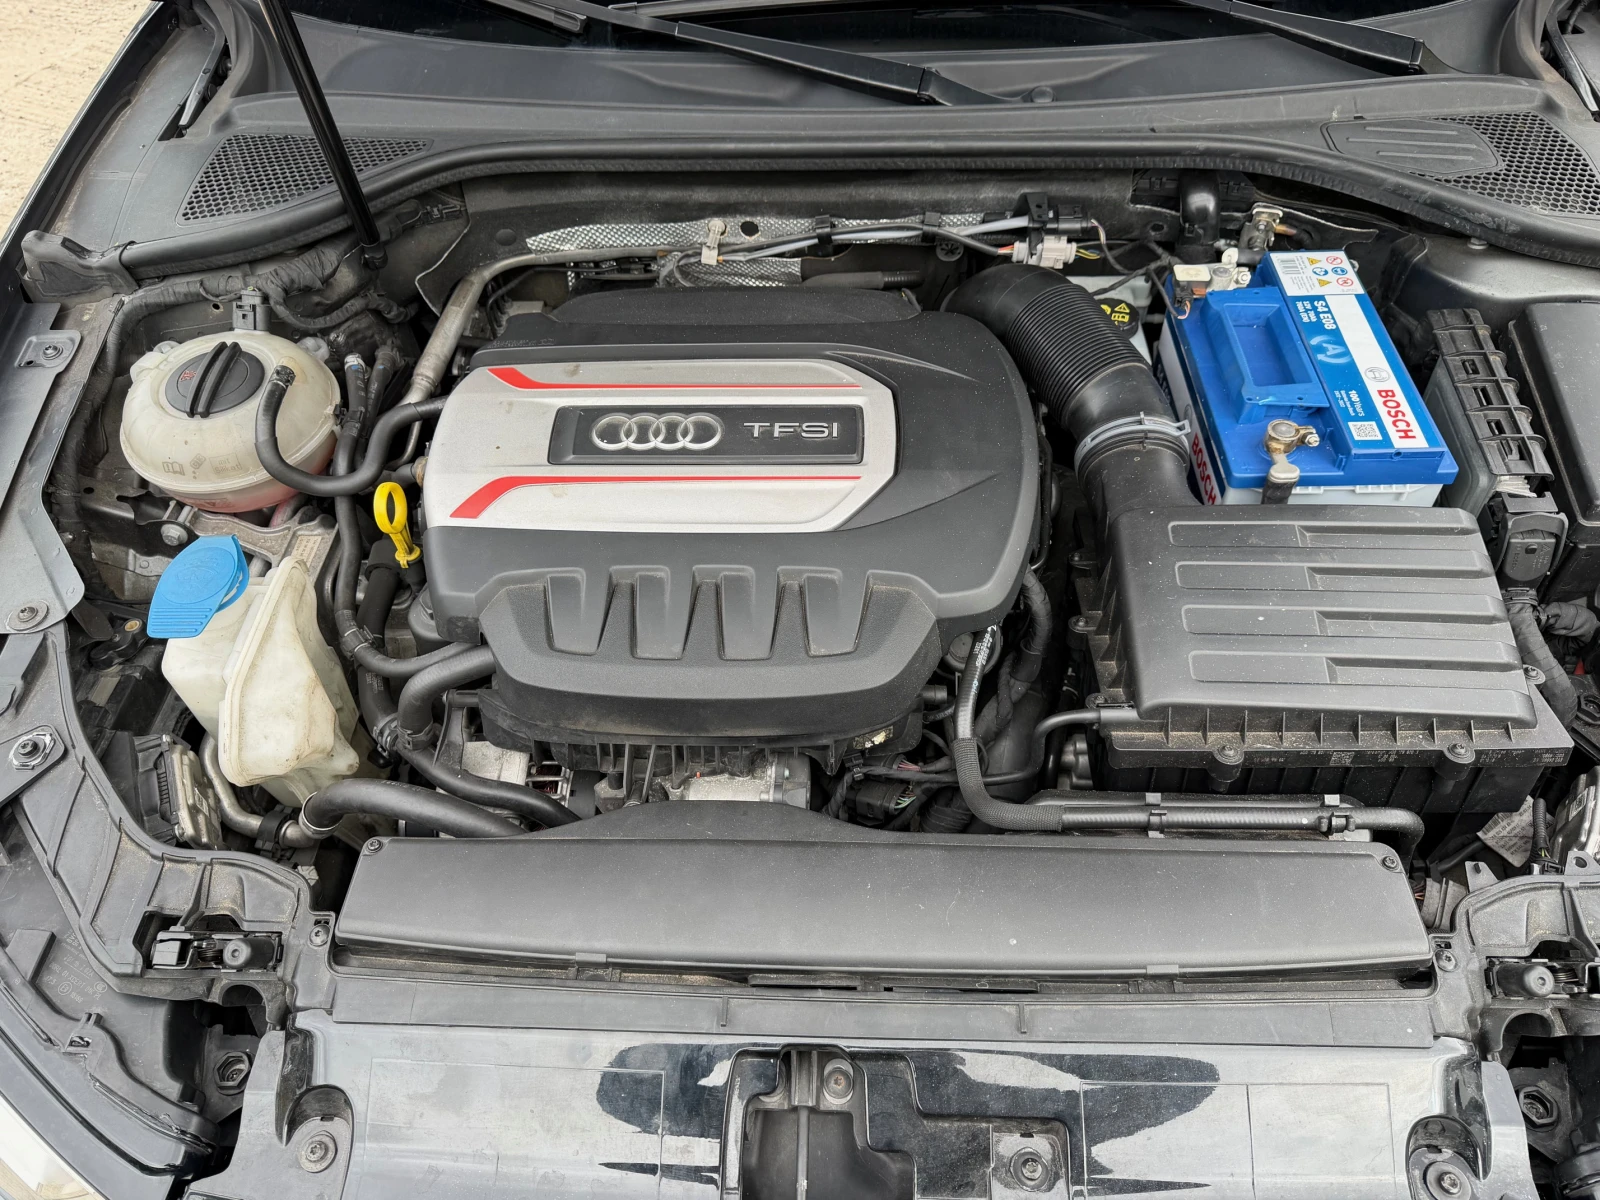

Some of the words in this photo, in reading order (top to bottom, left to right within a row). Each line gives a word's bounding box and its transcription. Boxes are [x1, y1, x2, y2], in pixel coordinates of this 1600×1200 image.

[1313, 300, 1328, 312] S4
[1319, 313, 1336, 330] E08
[1348, 389, 1360, 402] 100
[1353, 400, 1366, 417] Years
[1377, 389, 1417, 440] BOSCH
[743, 422, 839, 440] TFSI
[1191, 432, 1217, 505] BOSCH
